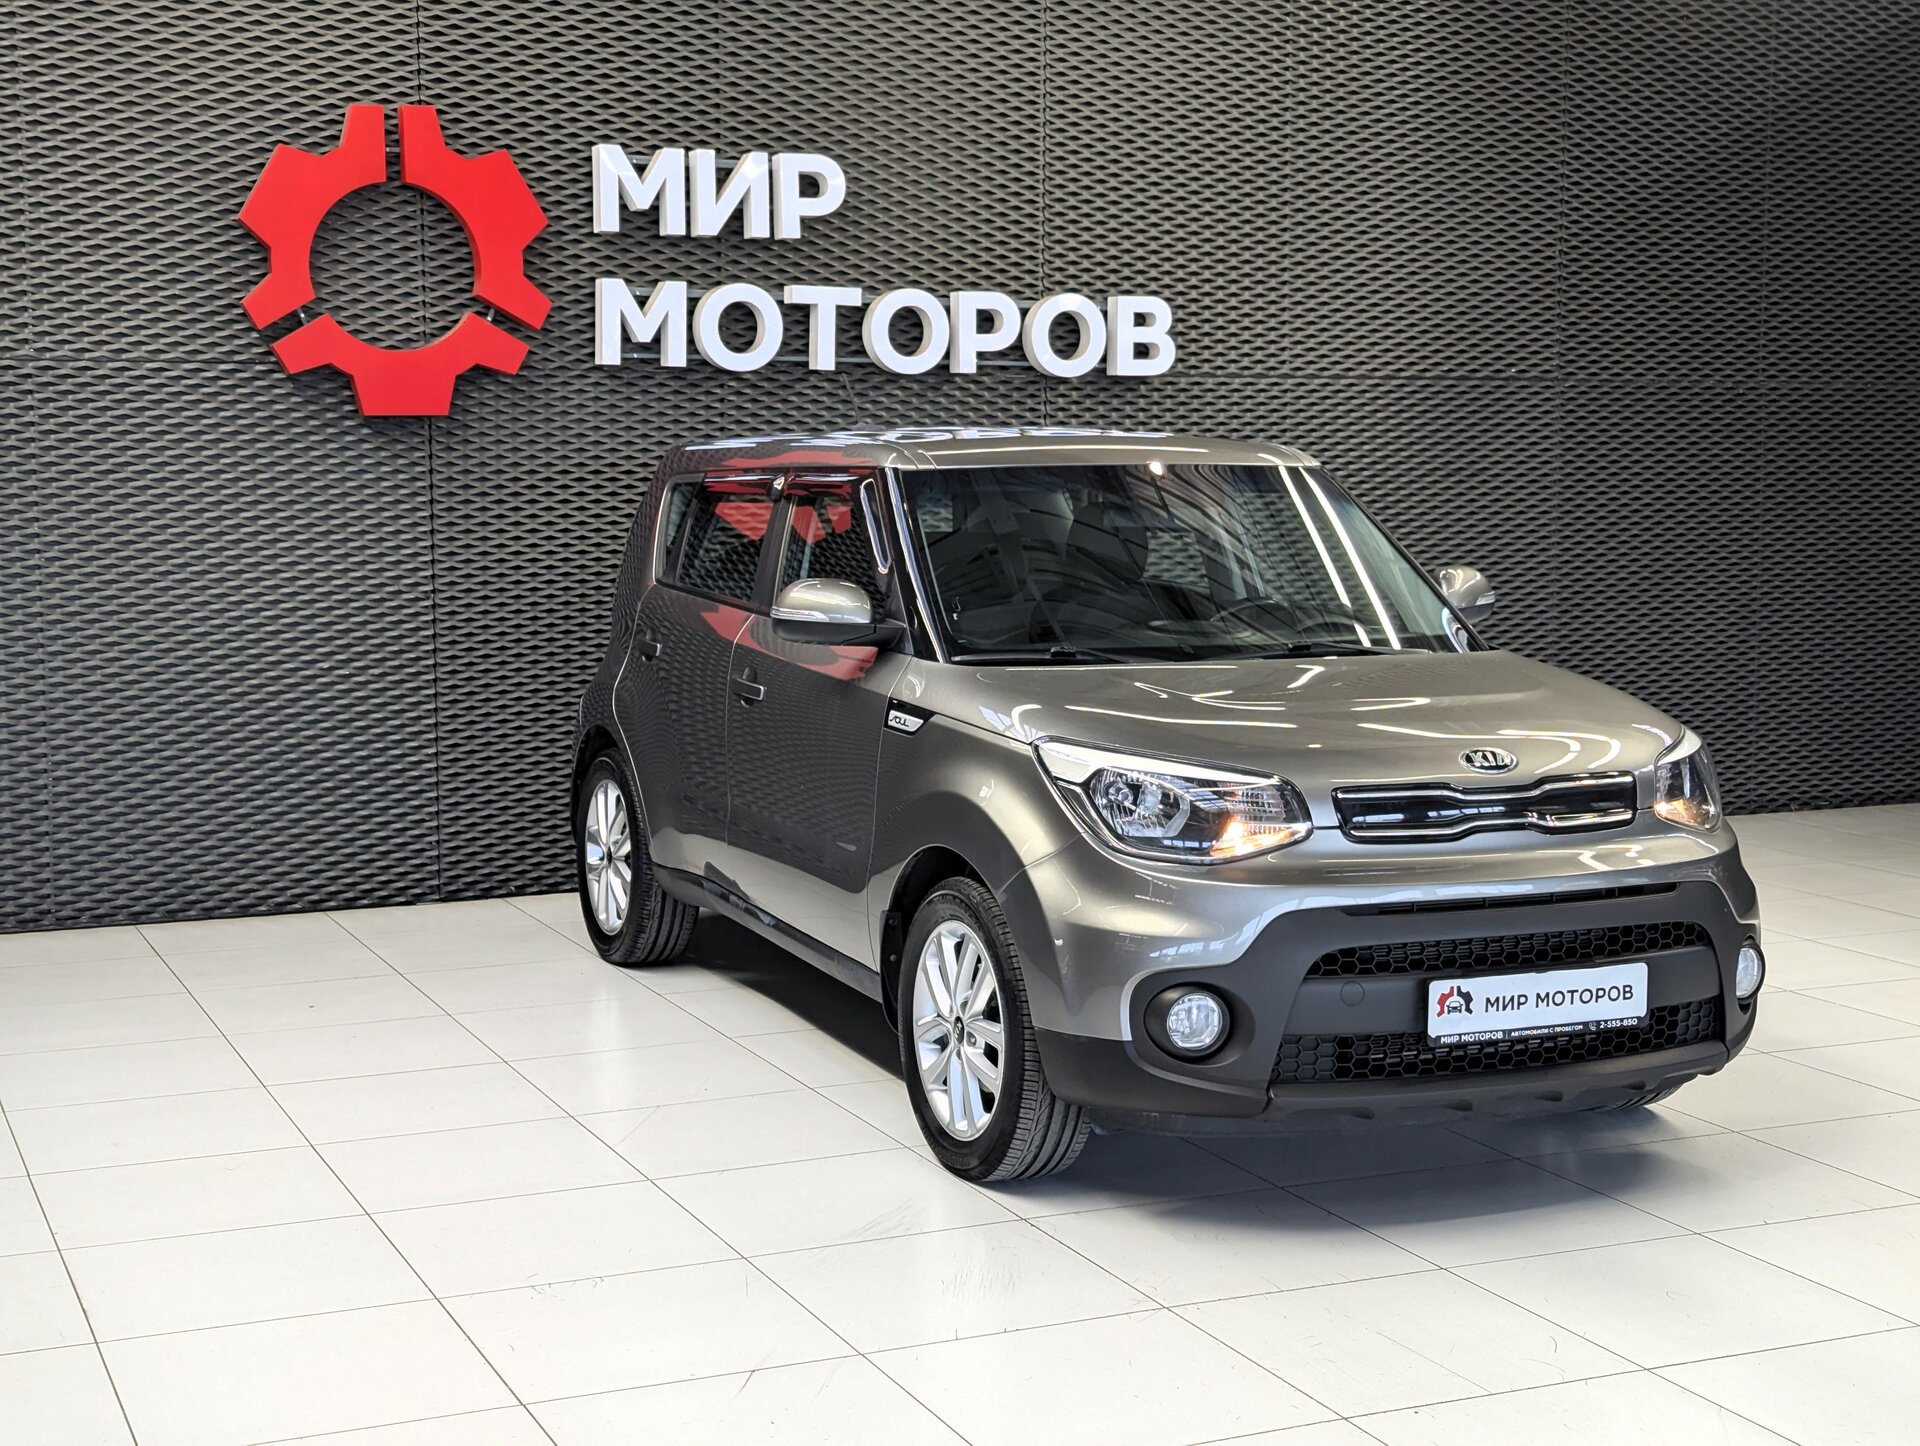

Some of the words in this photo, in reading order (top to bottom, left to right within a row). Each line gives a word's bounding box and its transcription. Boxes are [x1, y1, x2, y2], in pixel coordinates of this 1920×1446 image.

[592, 144, 846, 239] МИР
[595, 278, 1176, 377] МОТОРОВ
[1469, 751, 1511, 767] KIA
[1485, 994, 1528, 1012] МИР
[1535, 985, 1634, 1008] МОТОРОВ
[1600, 1018, 1638, 1029] 2-555-850
[1441, 1034, 1460, 1044] МИР
[1461, 1031, 1503, 1042] МОТОРОВ
